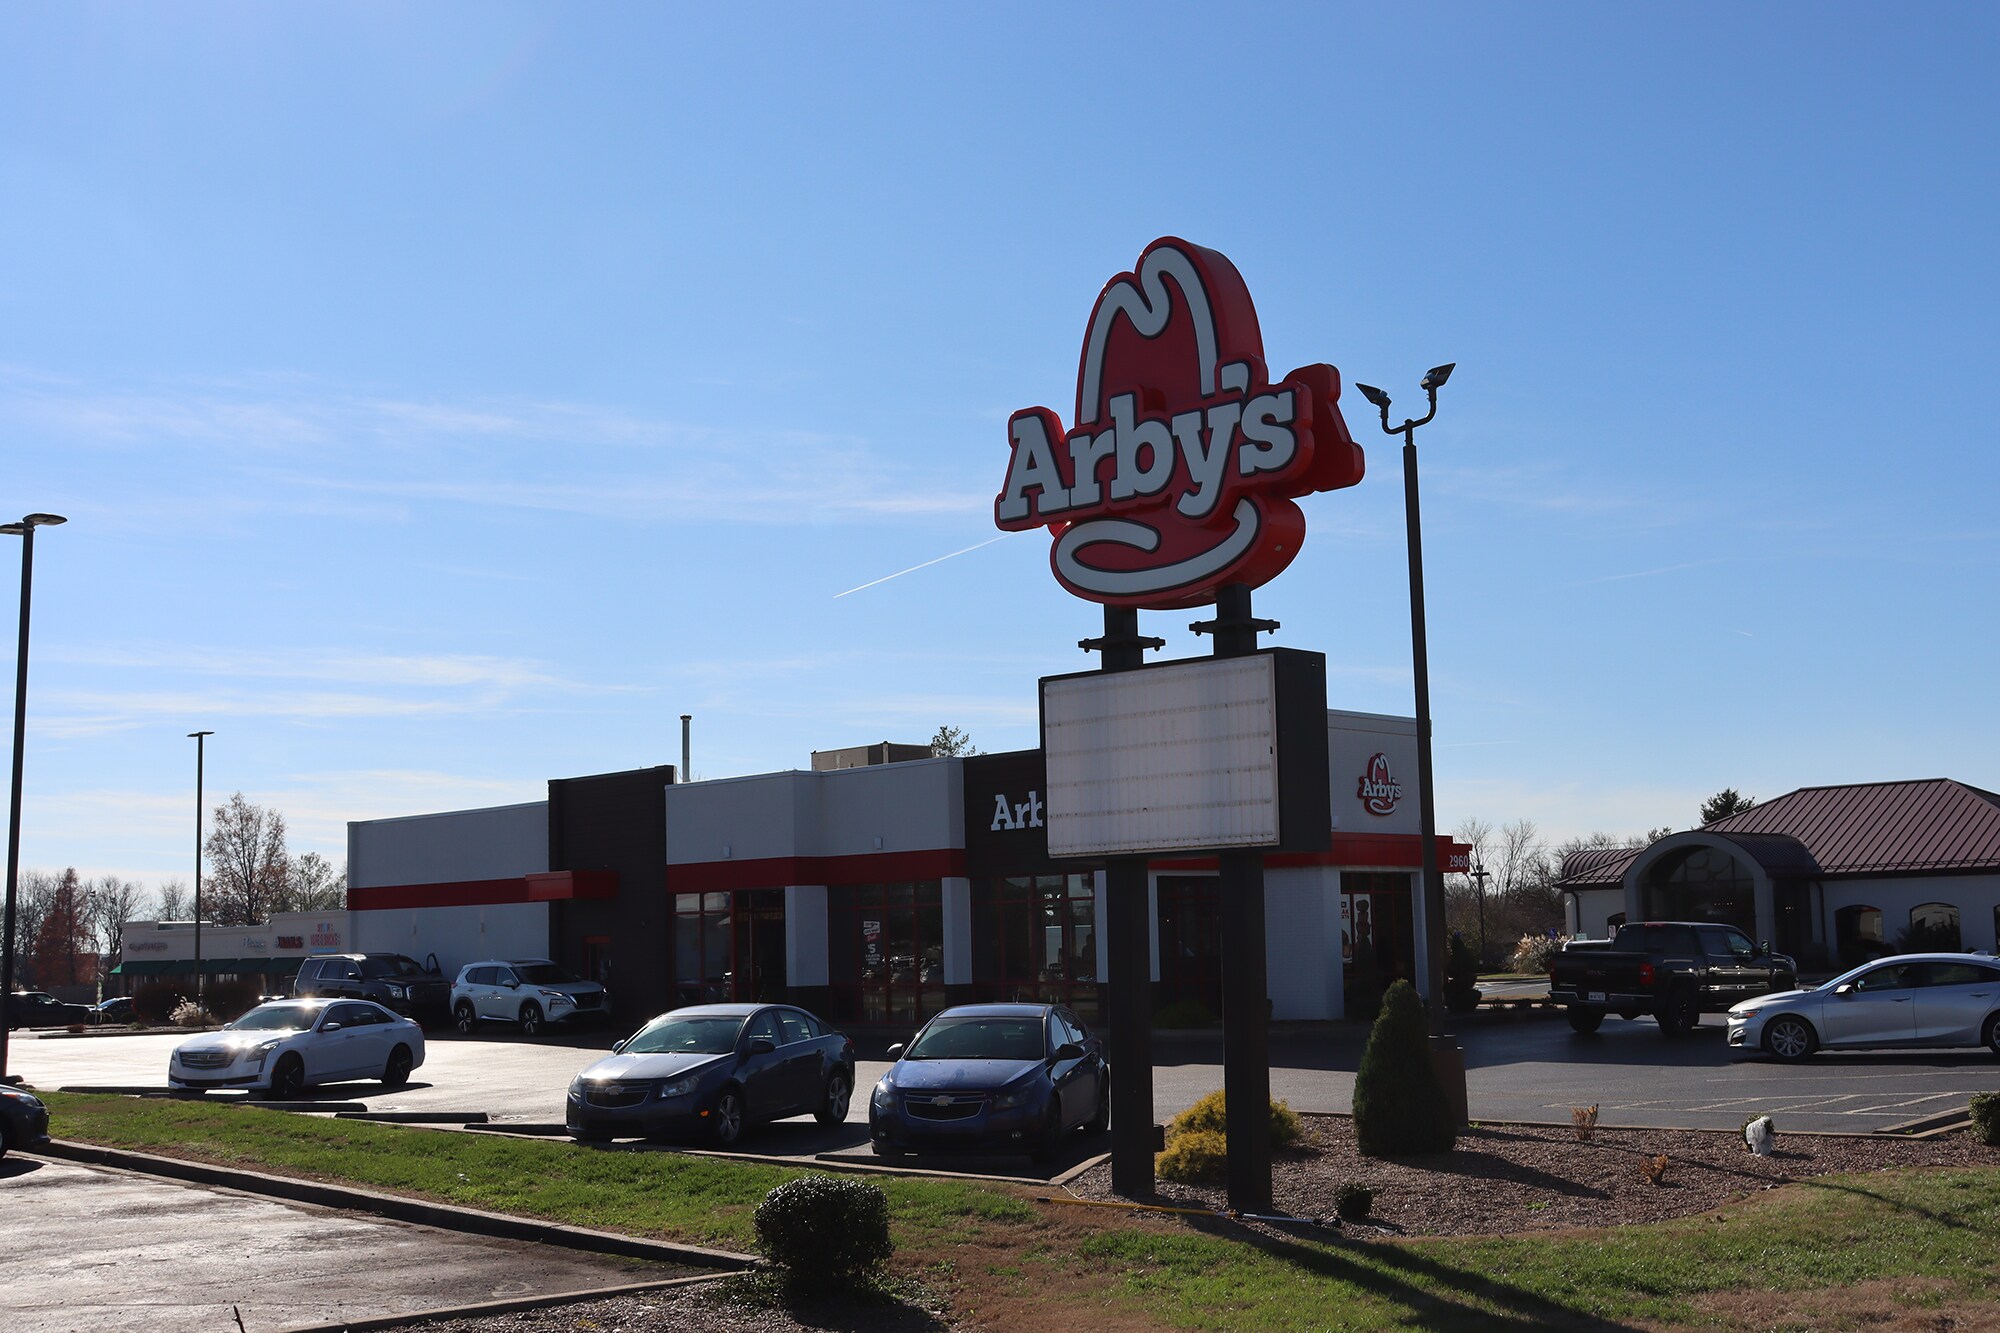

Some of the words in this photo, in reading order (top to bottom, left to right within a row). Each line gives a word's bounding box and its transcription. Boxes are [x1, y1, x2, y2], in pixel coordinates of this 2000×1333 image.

[998, 363, 1294, 517] Arby's
[1362, 778, 1402, 802] Arby's
[1449, 855, 1469, 867] 2960
